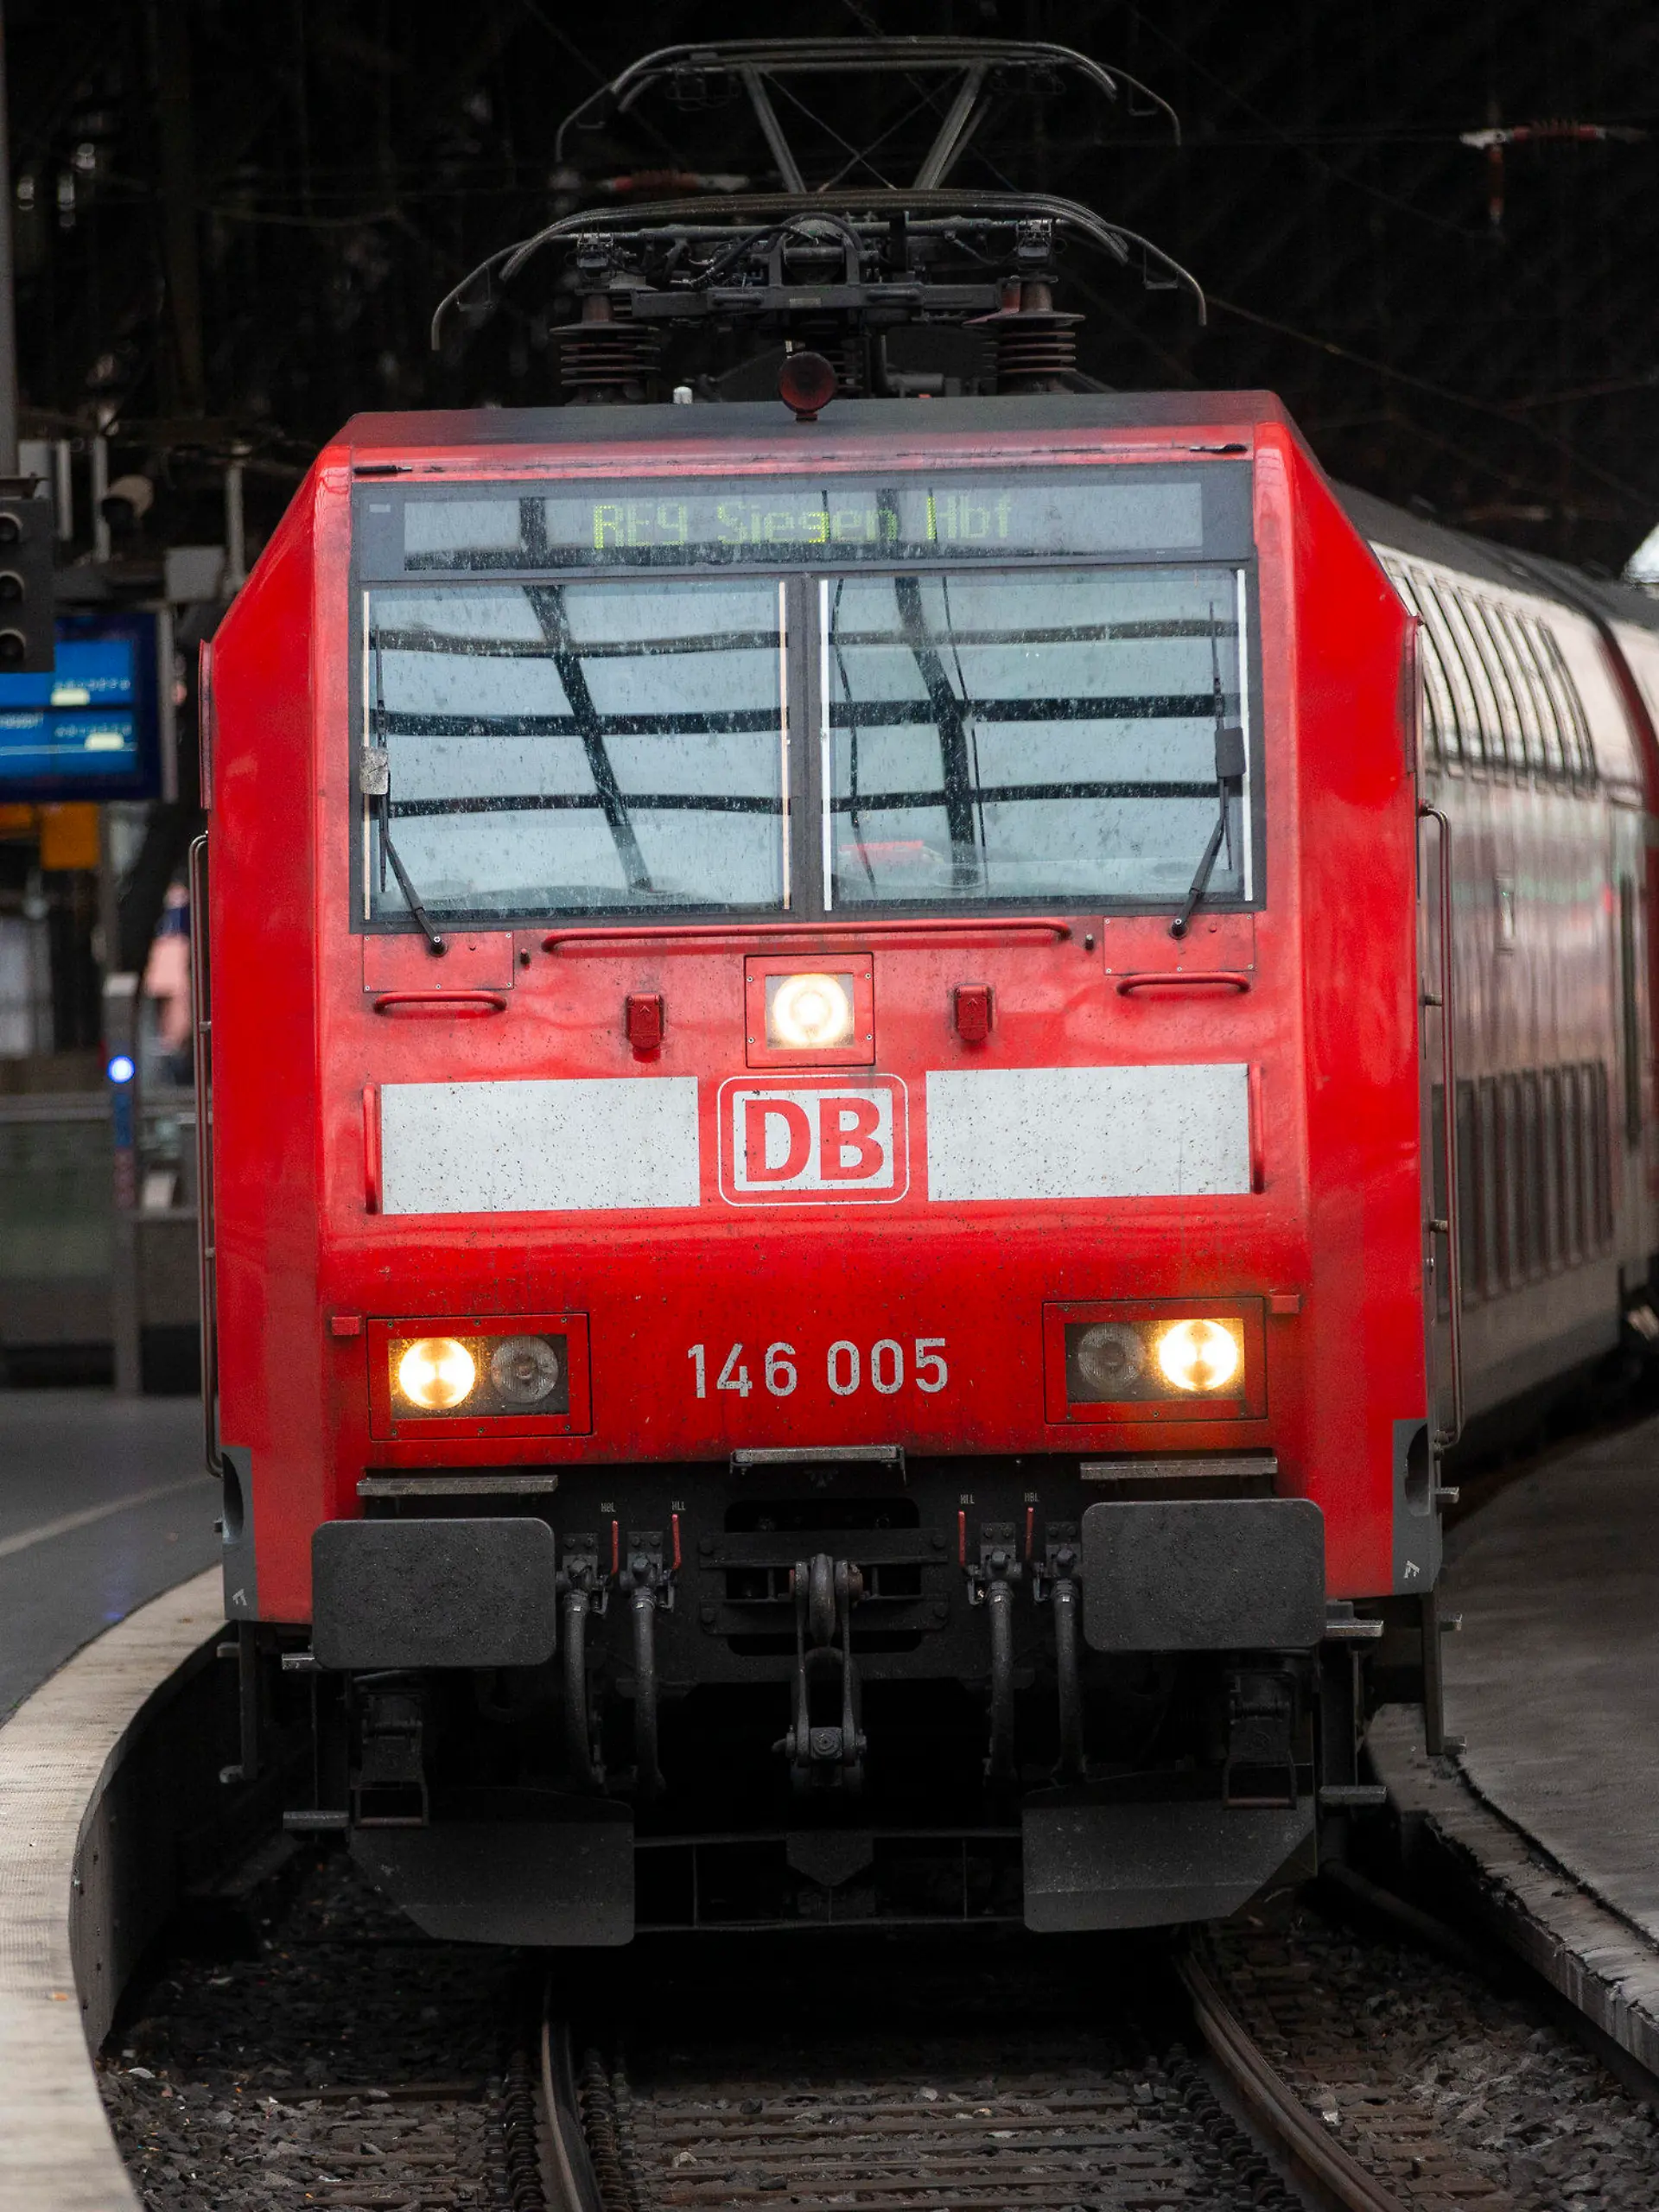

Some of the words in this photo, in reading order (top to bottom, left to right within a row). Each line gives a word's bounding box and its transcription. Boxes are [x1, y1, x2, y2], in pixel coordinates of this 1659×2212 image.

[594, 503, 688, 550] RE9
[717, 499, 898, 544] Siegen
[925, 494, 1013, 540] Hbf
[745, 1096, 885, 1182] DB
[687, 1341, 798, 1399] 146
[827, 1338, 948, 1396] 005
